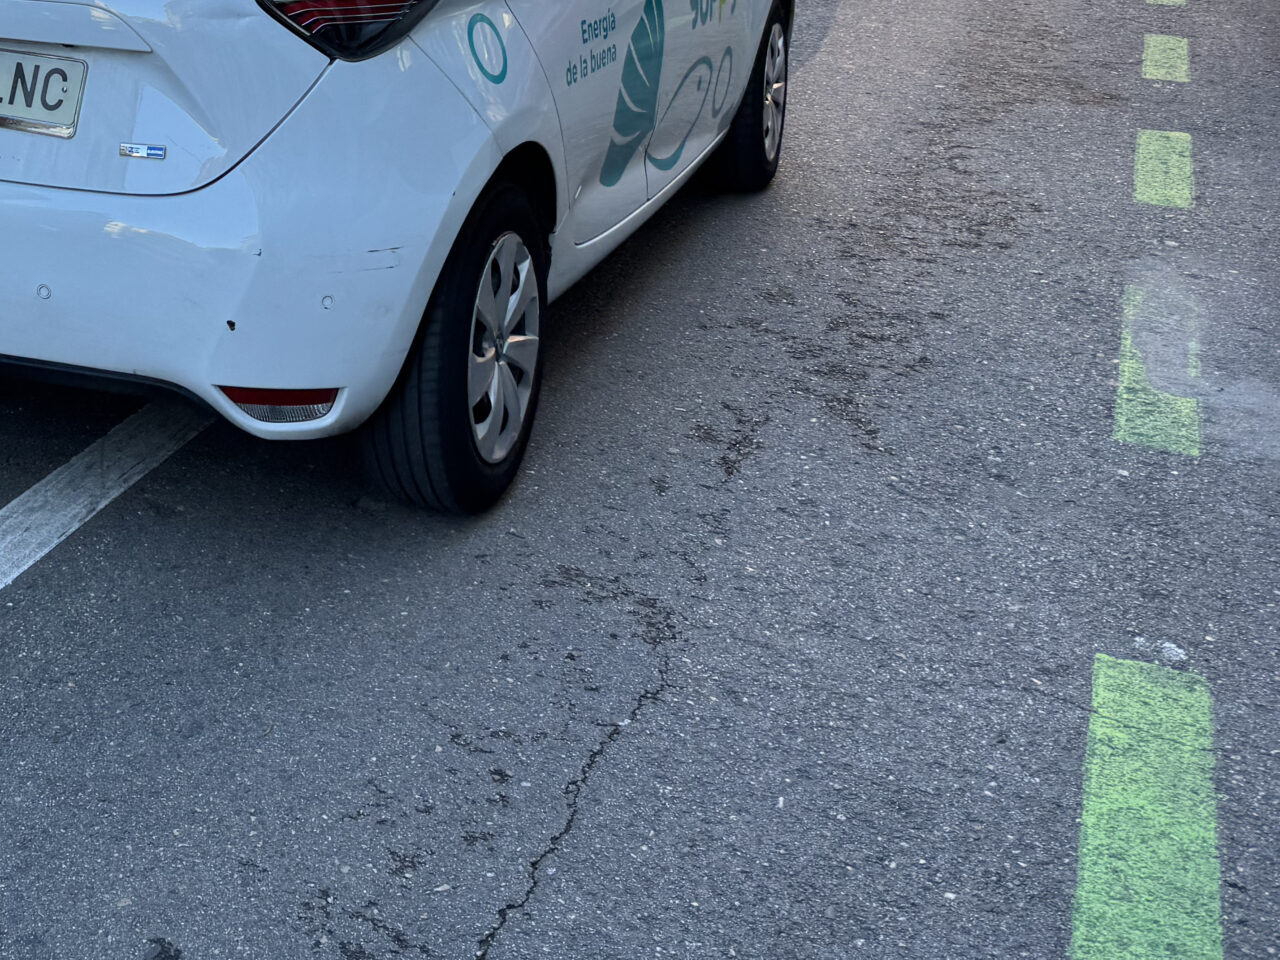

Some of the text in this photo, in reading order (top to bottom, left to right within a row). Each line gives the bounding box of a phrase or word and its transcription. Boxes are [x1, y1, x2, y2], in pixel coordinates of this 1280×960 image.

[580, 8, 616, 45] Energía
[565, 43, 617, 87] de la buena
